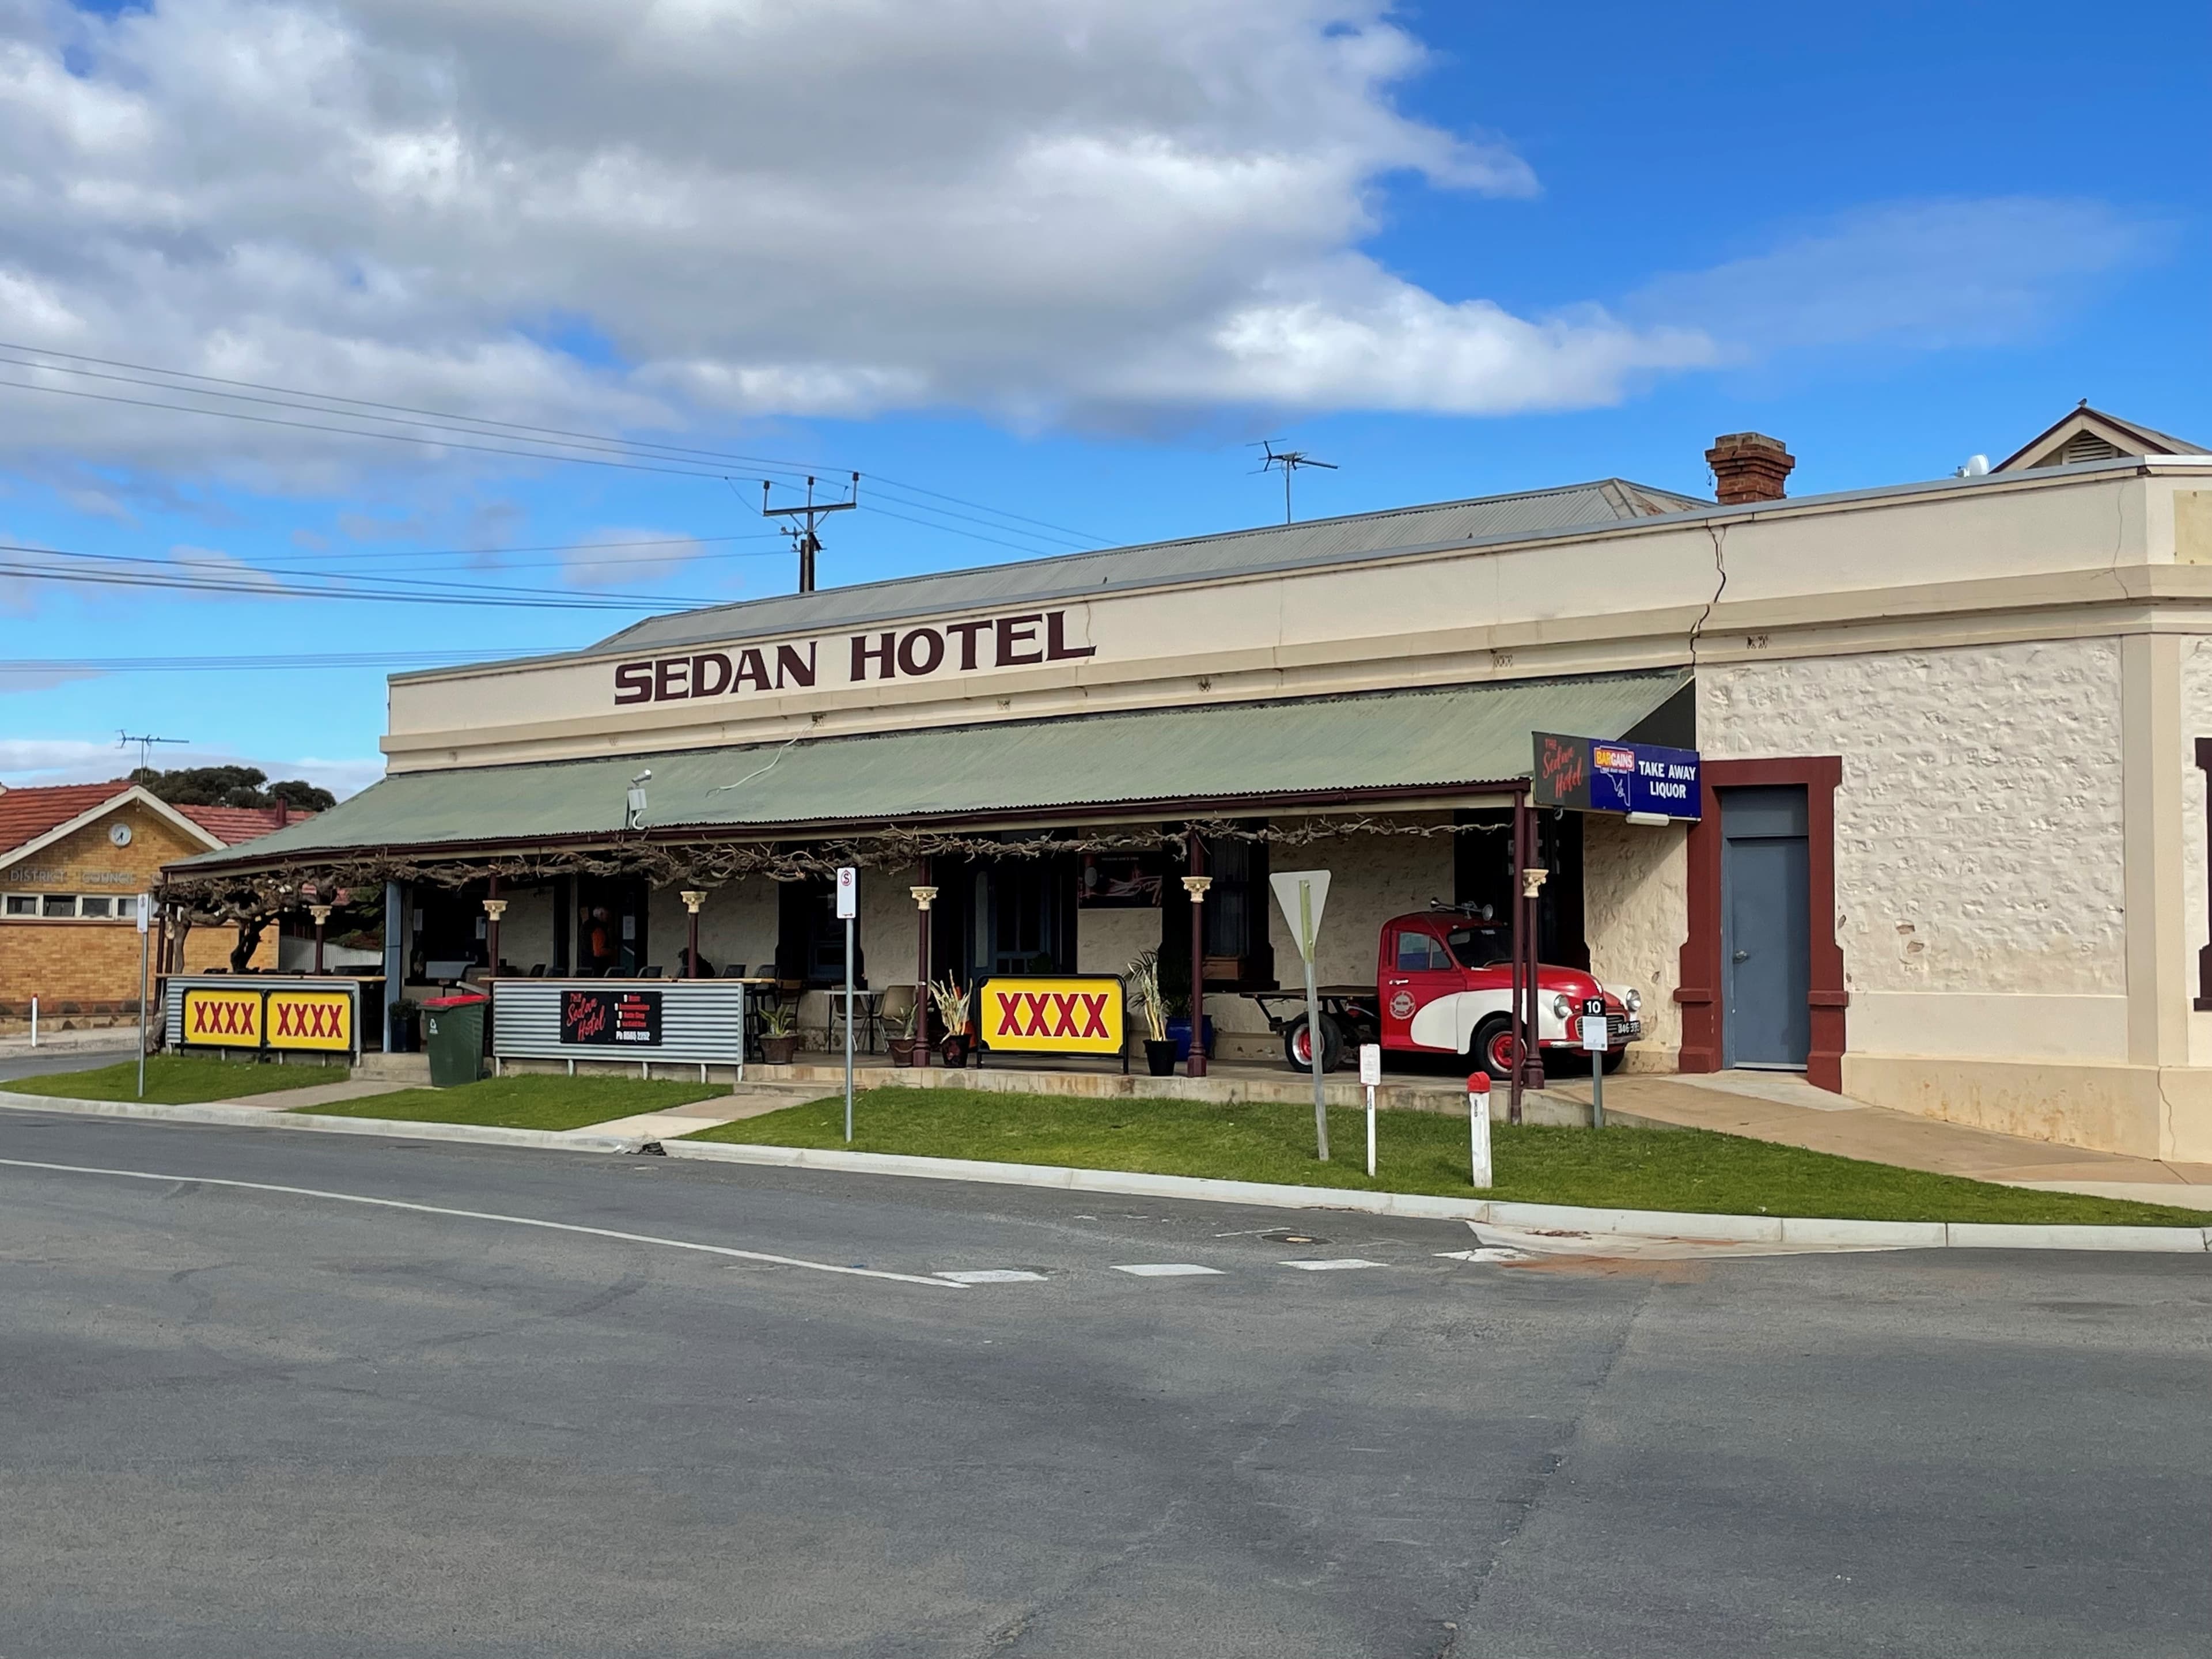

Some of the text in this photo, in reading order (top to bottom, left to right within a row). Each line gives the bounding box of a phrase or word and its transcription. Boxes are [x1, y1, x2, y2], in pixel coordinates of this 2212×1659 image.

[613, 610, 1097, 706] SEDAN HOTEL
[1542, 745, 1575, 779] Sedan
[1596, 751, 1633, 768] BARGAINS
[1638, 760, 1696, 781] TAKE AWAY
[1555, 756, 1583, 798] Hotel
[1650, 781, 1687, 799] LIQUOR
[10, 869, 67, 882] DISTRICT
[194, 1001, 343, 1039] XXXX XXXX
[566, 997, 597, 1027] Sedan
[578, 1005, 605, 1041] Hotel
[997, 993, 1110, 1039] XXXX
[1586, 1001, 1601, 1014] 10
